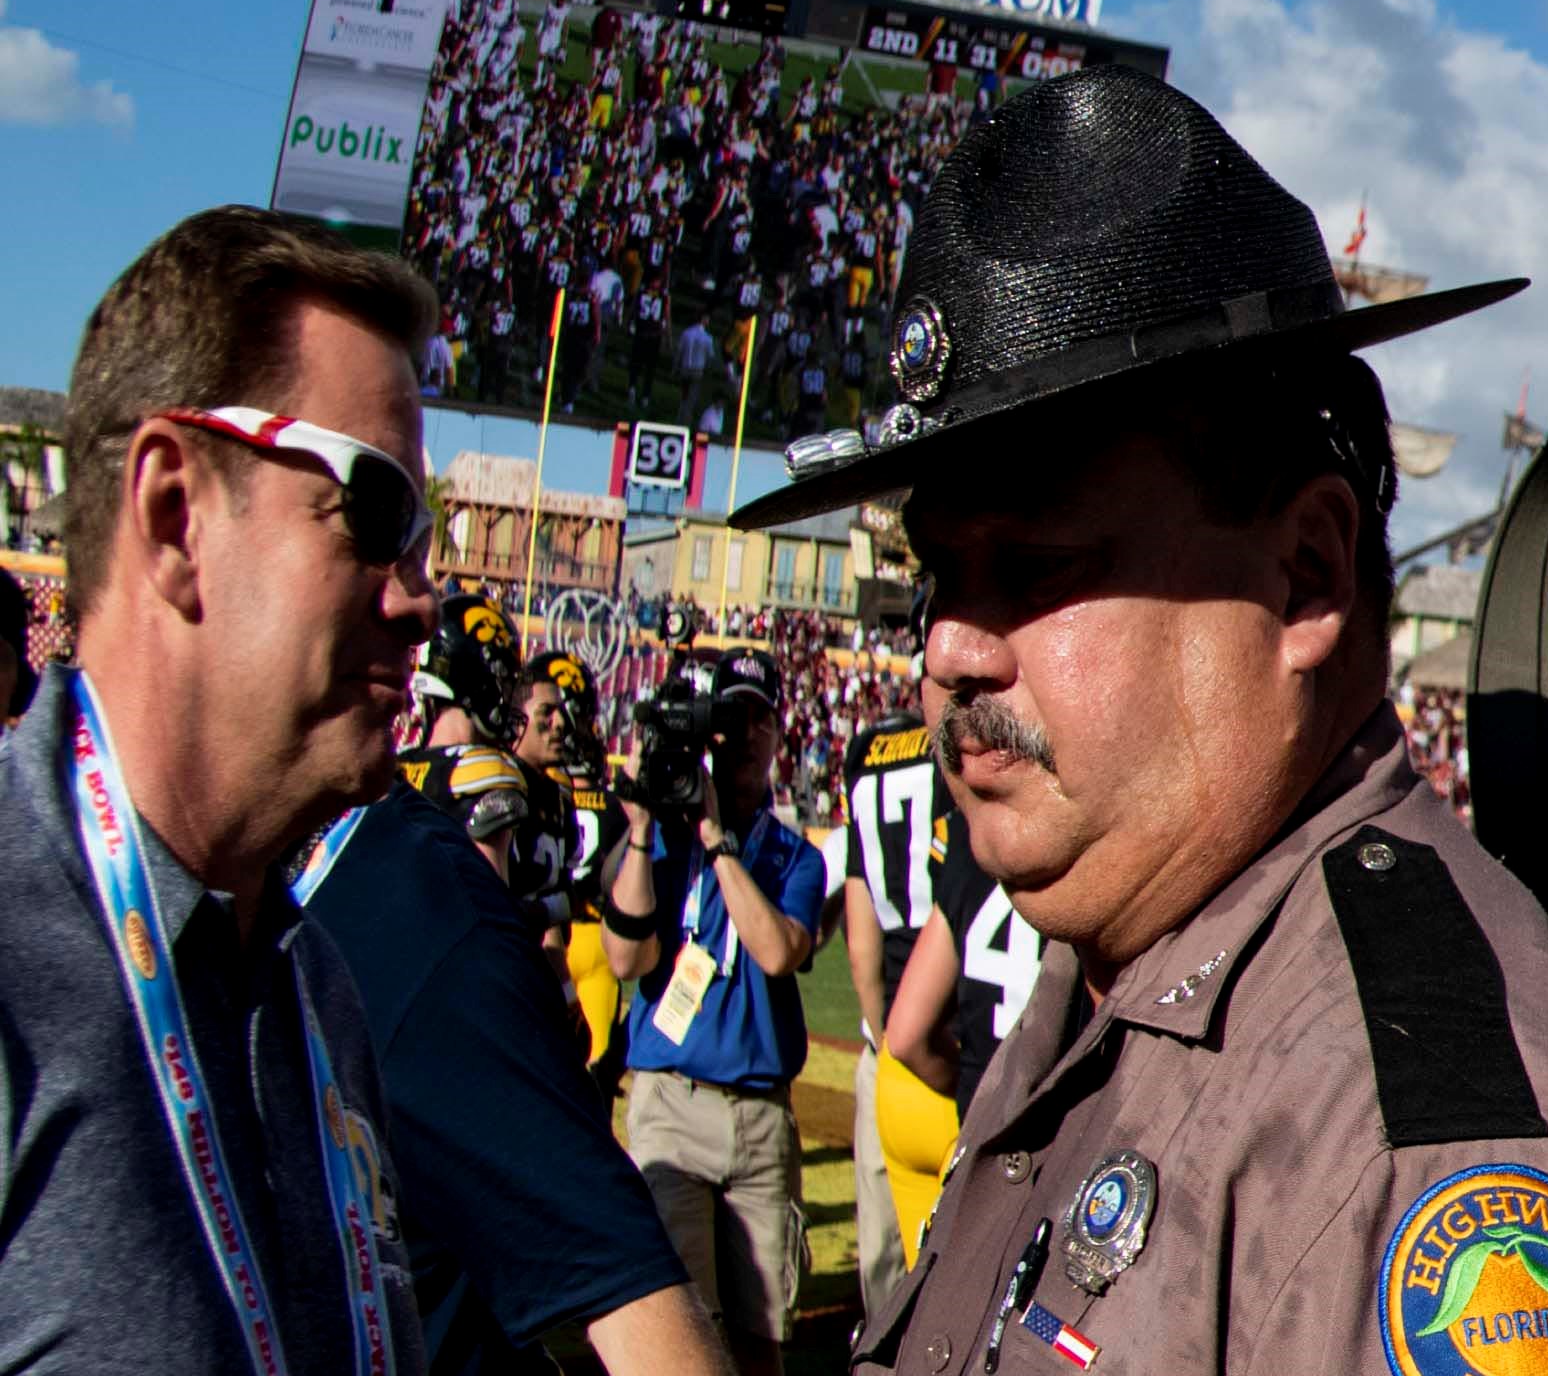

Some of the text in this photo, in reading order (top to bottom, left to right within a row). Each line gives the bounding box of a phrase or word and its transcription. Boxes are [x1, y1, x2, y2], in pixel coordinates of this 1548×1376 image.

[867, 26, 919, 58] 2ND
[290, 115, 405, 165] Publix
[635, 432, 683, 476] 39
[85, 768, 125, 857] BOWL
[851, 761, 935, 932] 17
[187, 1109, 241, 1254] MILLION
[235, 1263, 259, 1310] TO
[346, 1201, 375, 1294] BOWL
